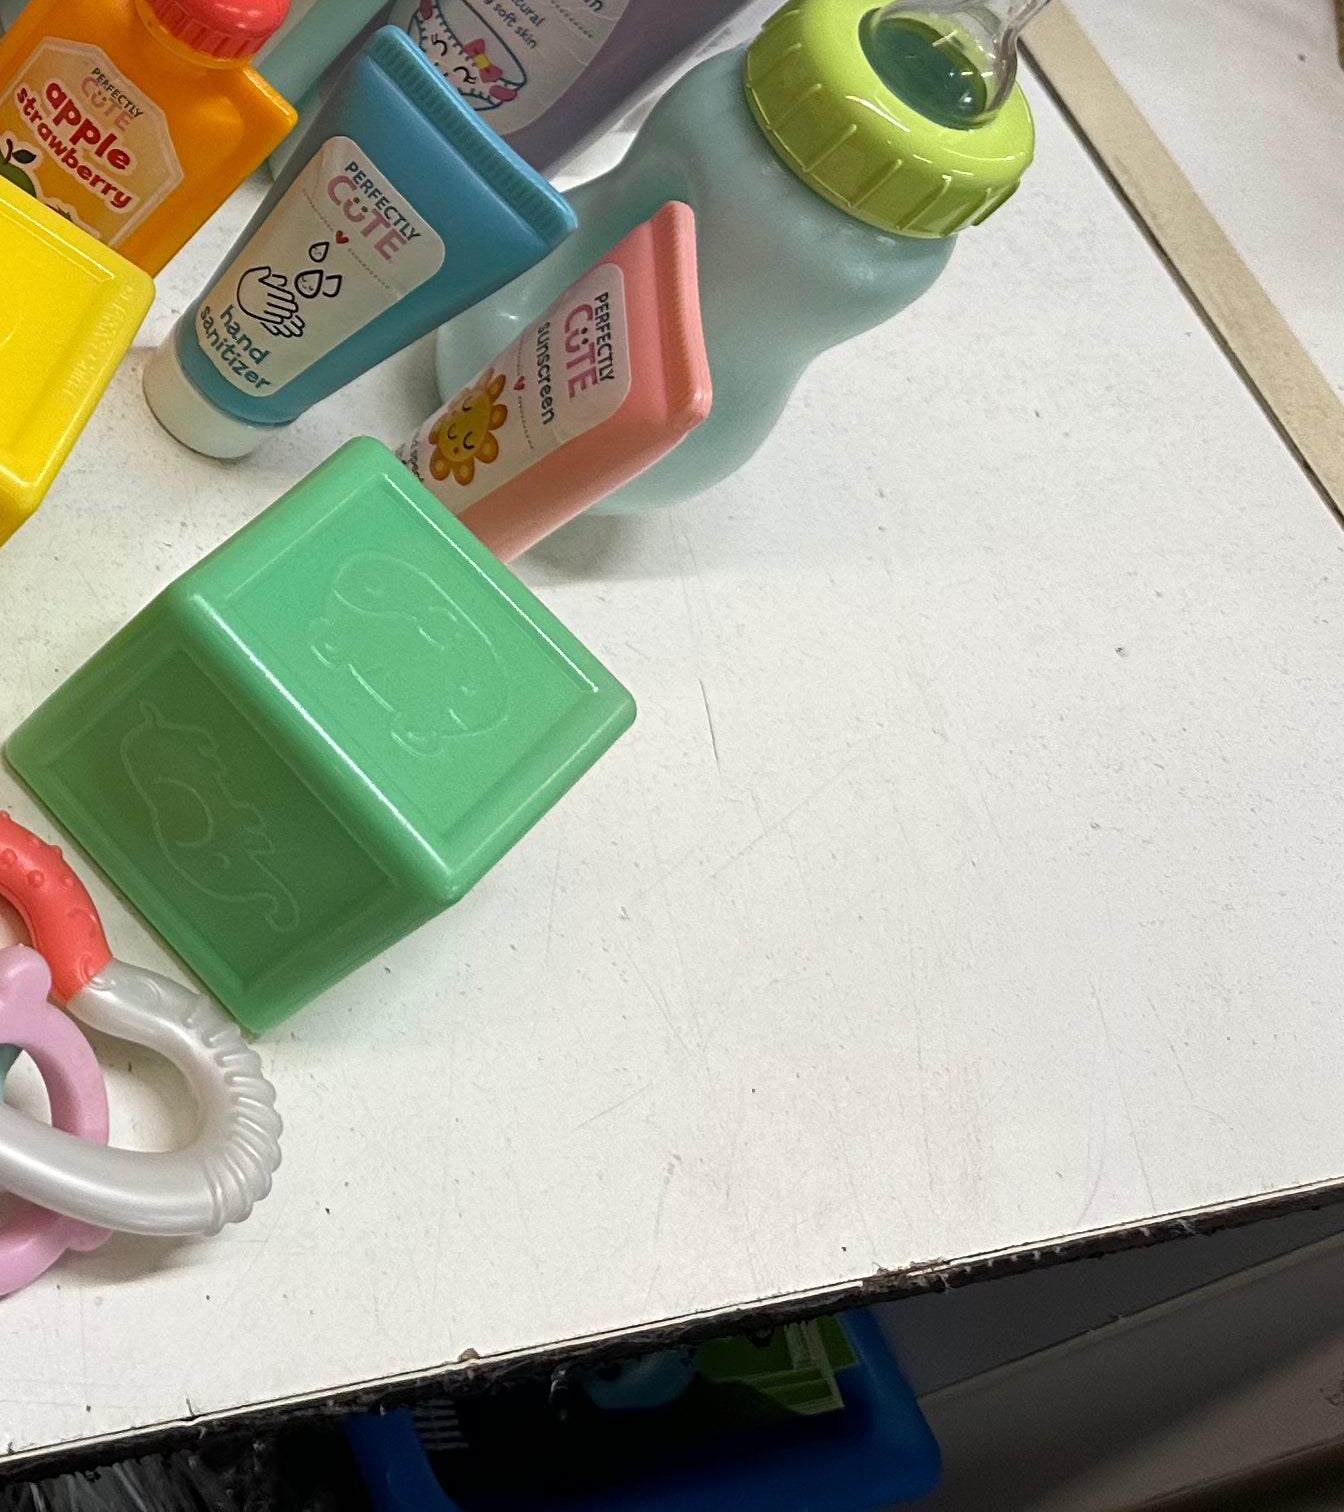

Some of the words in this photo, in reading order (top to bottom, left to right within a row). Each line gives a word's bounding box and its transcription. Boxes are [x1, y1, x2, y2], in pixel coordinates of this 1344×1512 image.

[492, 1, 519, 28] soft
[515, 23, 538, 50] skin
[45, 82, 131, 171] apple
[91, 67, 144, 119] PERFECTLY
[16, 86, 133, 209] strawberry
[345, 160, 421, 241] PERFECTLY
[199, 305, 272, 389] sanitizer
[219, 304, 272, 365] hand
[537, 321, 555, 425] sunscreen
[594, 291, 615, 382] PERFECTLY
